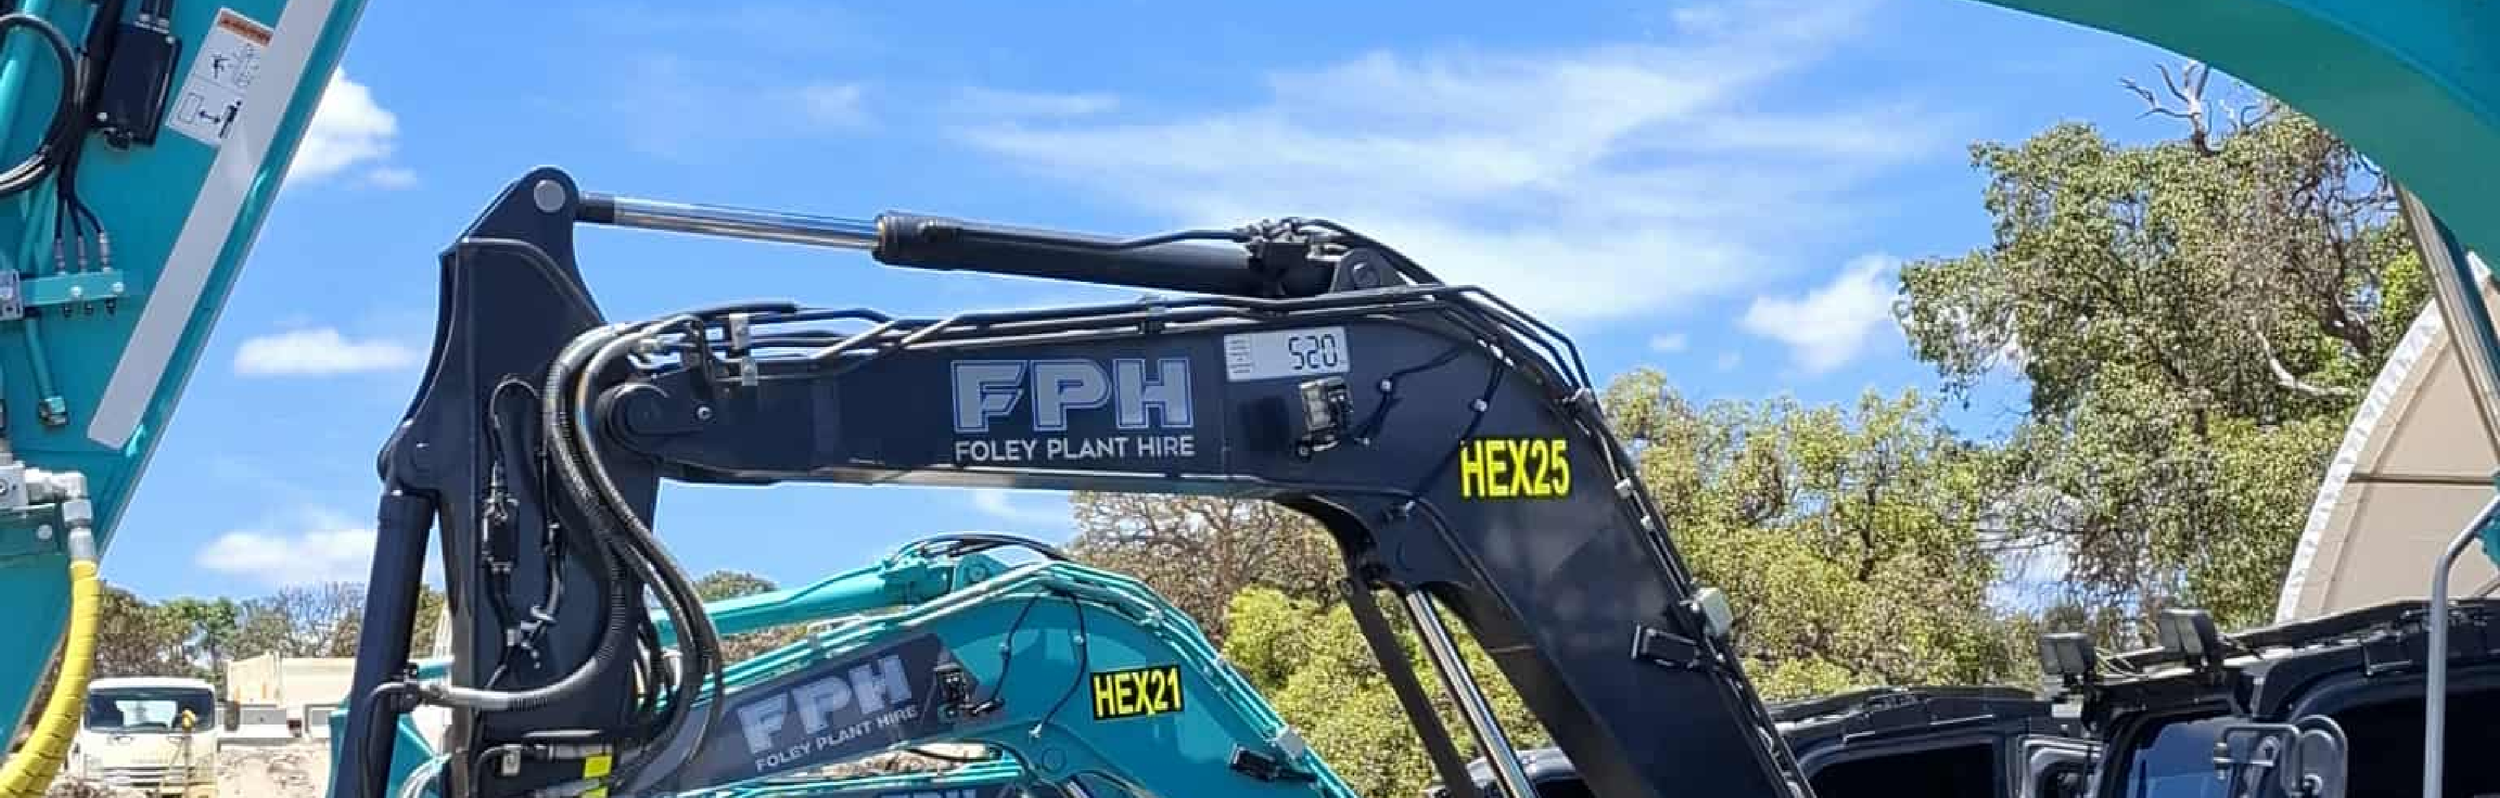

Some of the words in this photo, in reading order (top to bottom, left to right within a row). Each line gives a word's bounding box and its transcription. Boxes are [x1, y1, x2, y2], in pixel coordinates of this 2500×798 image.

[1288, 333, 1338, 370] 520
[951, 358, 1194, 433] FPH
[955, 440, 1037, 462] FOLEY
[1046, 436, 1129, 460] PLANT
[1137, 435, 1196, 459] HIRE
[1460, 438, 1571, 497] HEX25
[737, 655, 912, 754] FPH
[1093, 667, 1181, 717] HEX21
[755, 741, 811, 771] FOLEY
[816, 720, 873, 750] PLANT
[877, 703, 918, 728] HIRE
